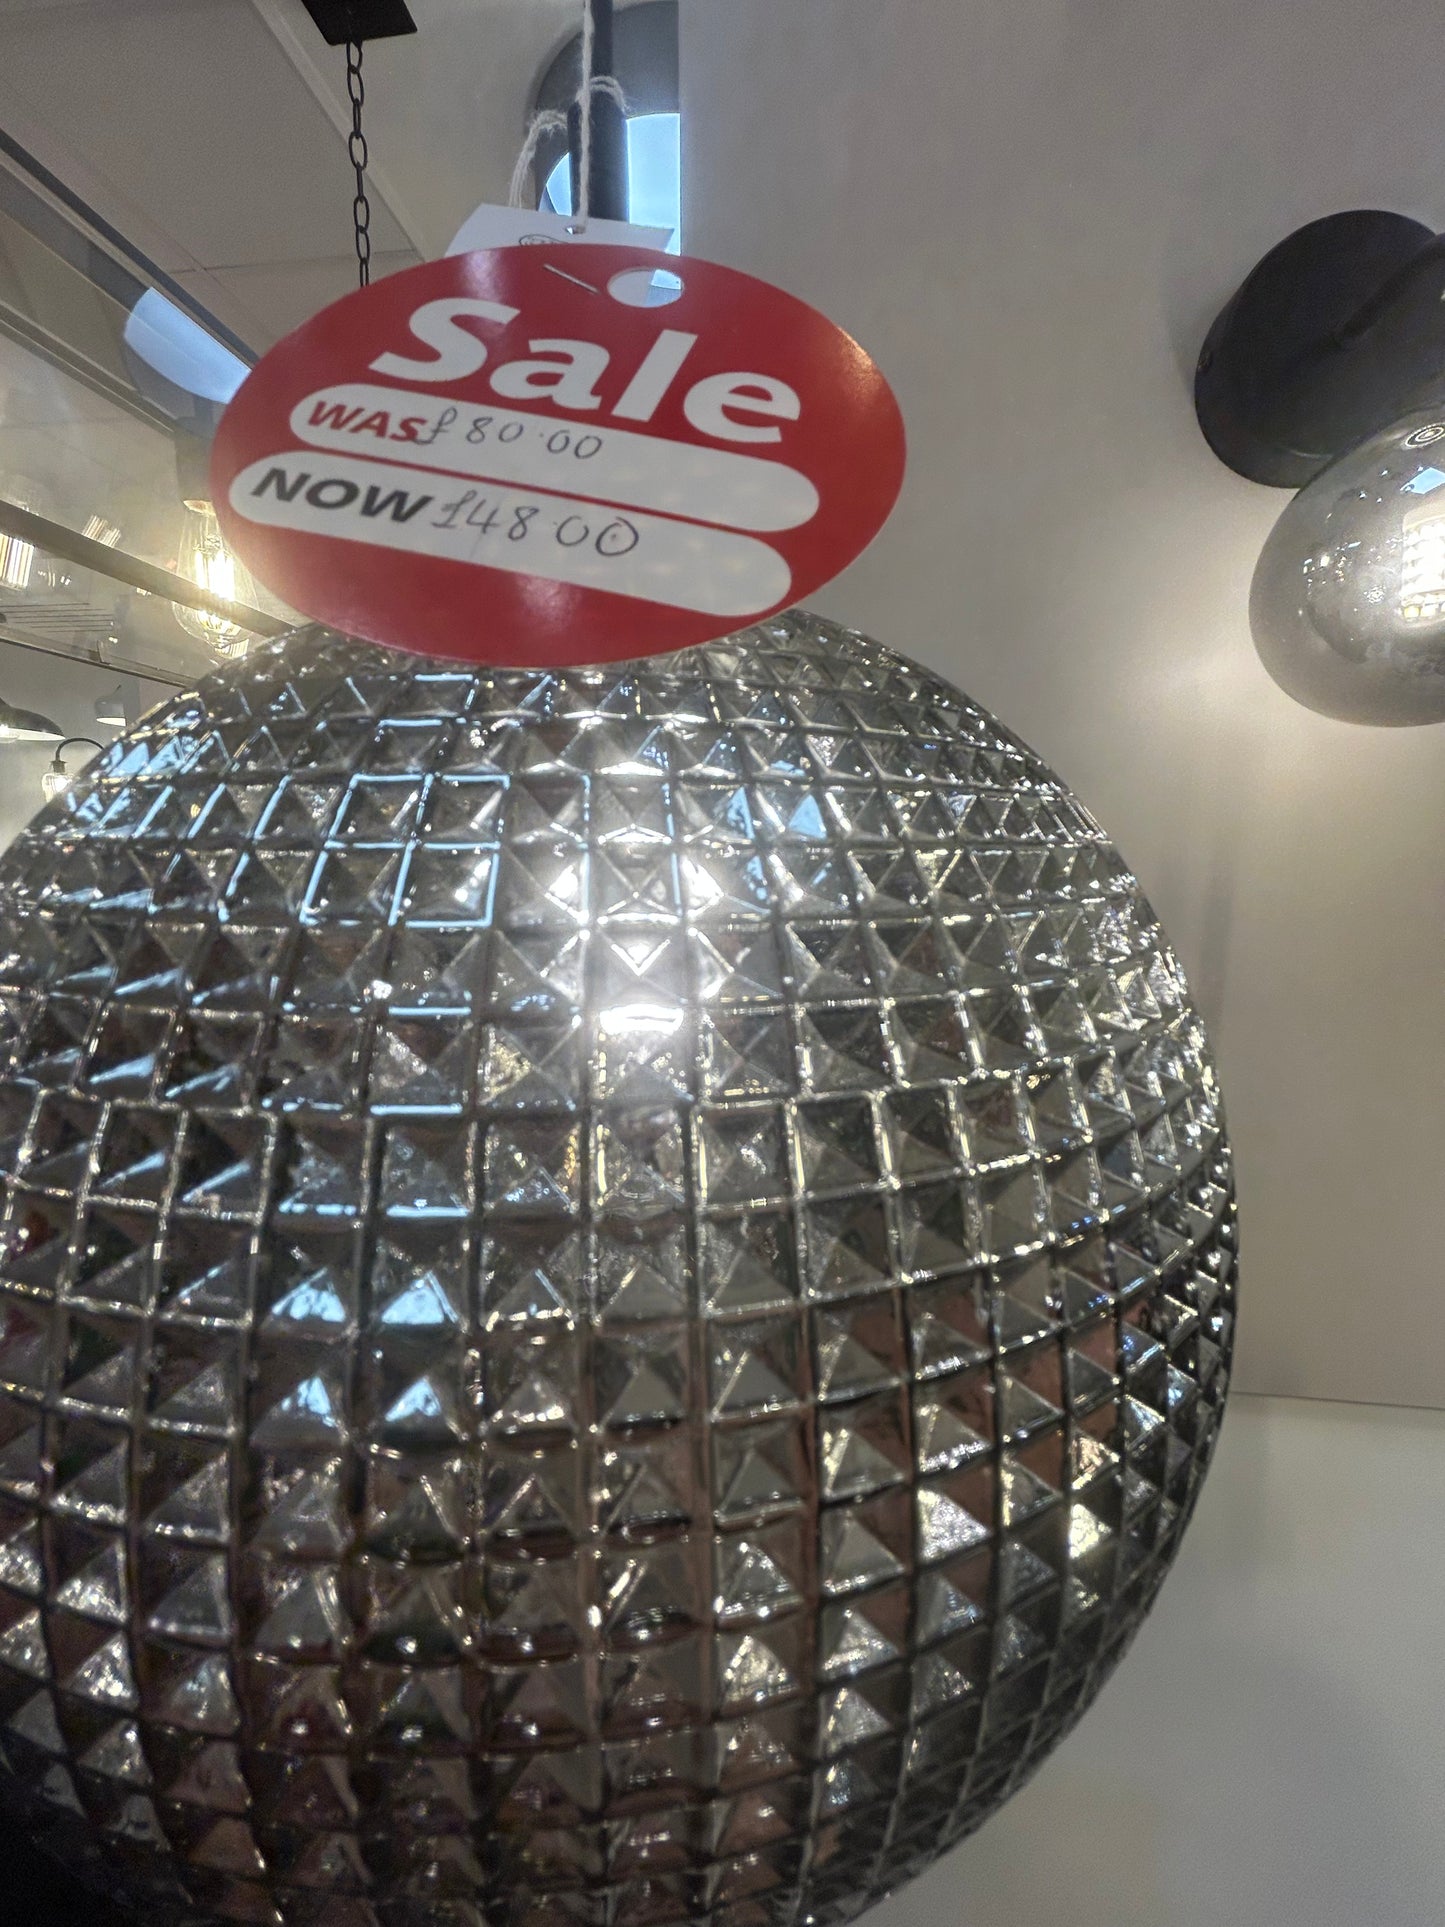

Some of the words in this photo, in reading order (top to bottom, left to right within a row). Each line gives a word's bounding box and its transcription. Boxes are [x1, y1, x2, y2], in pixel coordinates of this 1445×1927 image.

[369, 298, 801, 443] Sale
[308, 400, 428, 442] WAS
[251, 467, 434, 523] NOW
